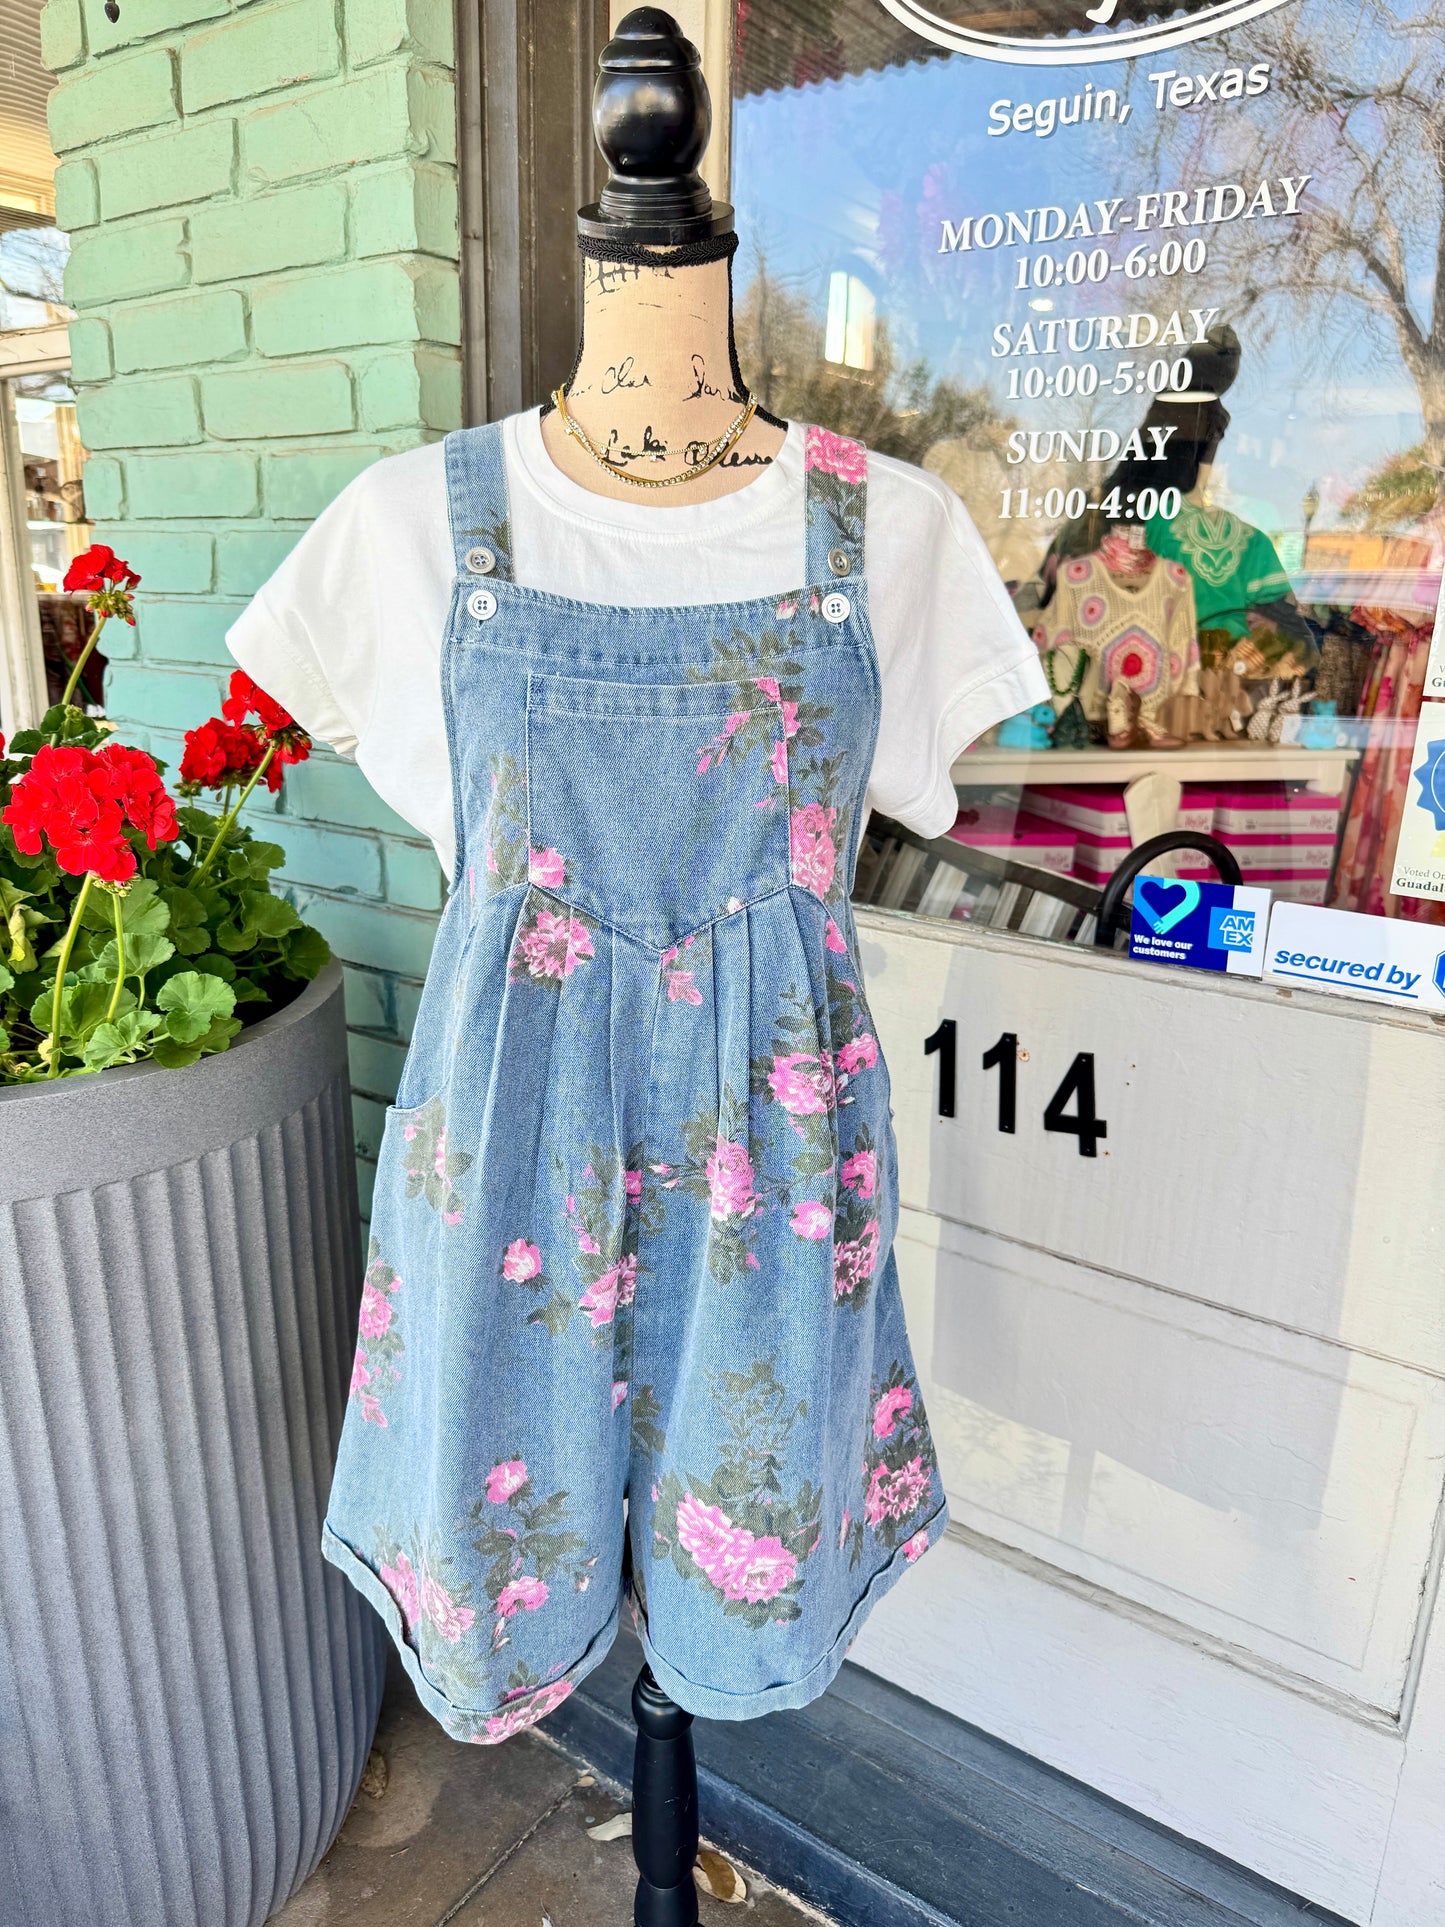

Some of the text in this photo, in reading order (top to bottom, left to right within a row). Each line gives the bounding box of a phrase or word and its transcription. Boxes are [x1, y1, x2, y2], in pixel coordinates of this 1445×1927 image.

[987, 62, 1271, 138] Seguin, Texas
[938, 175, 1314, 254] MONDAY-FRIDAY
[1015, 238, 1207, 290] 10:00-6:00
[991, 307, 1220, 358] SATURDAY
[1006, 358, 1193, 400] 10:00-5:00
[1006, 426, 1178, 465] SUNDAY
[999, 487, 1183, 521] 11:00-4:00
[1404, 866, 1430, 878] Voted
[1134, 934, 1193, 950] We love our
[1219, 914, 1255, 932] AM
[1133, 946, 1187, 960] customers
[1274, 949, 1422, 990] secured by
[925, 1018, 1107, 1158] 114
